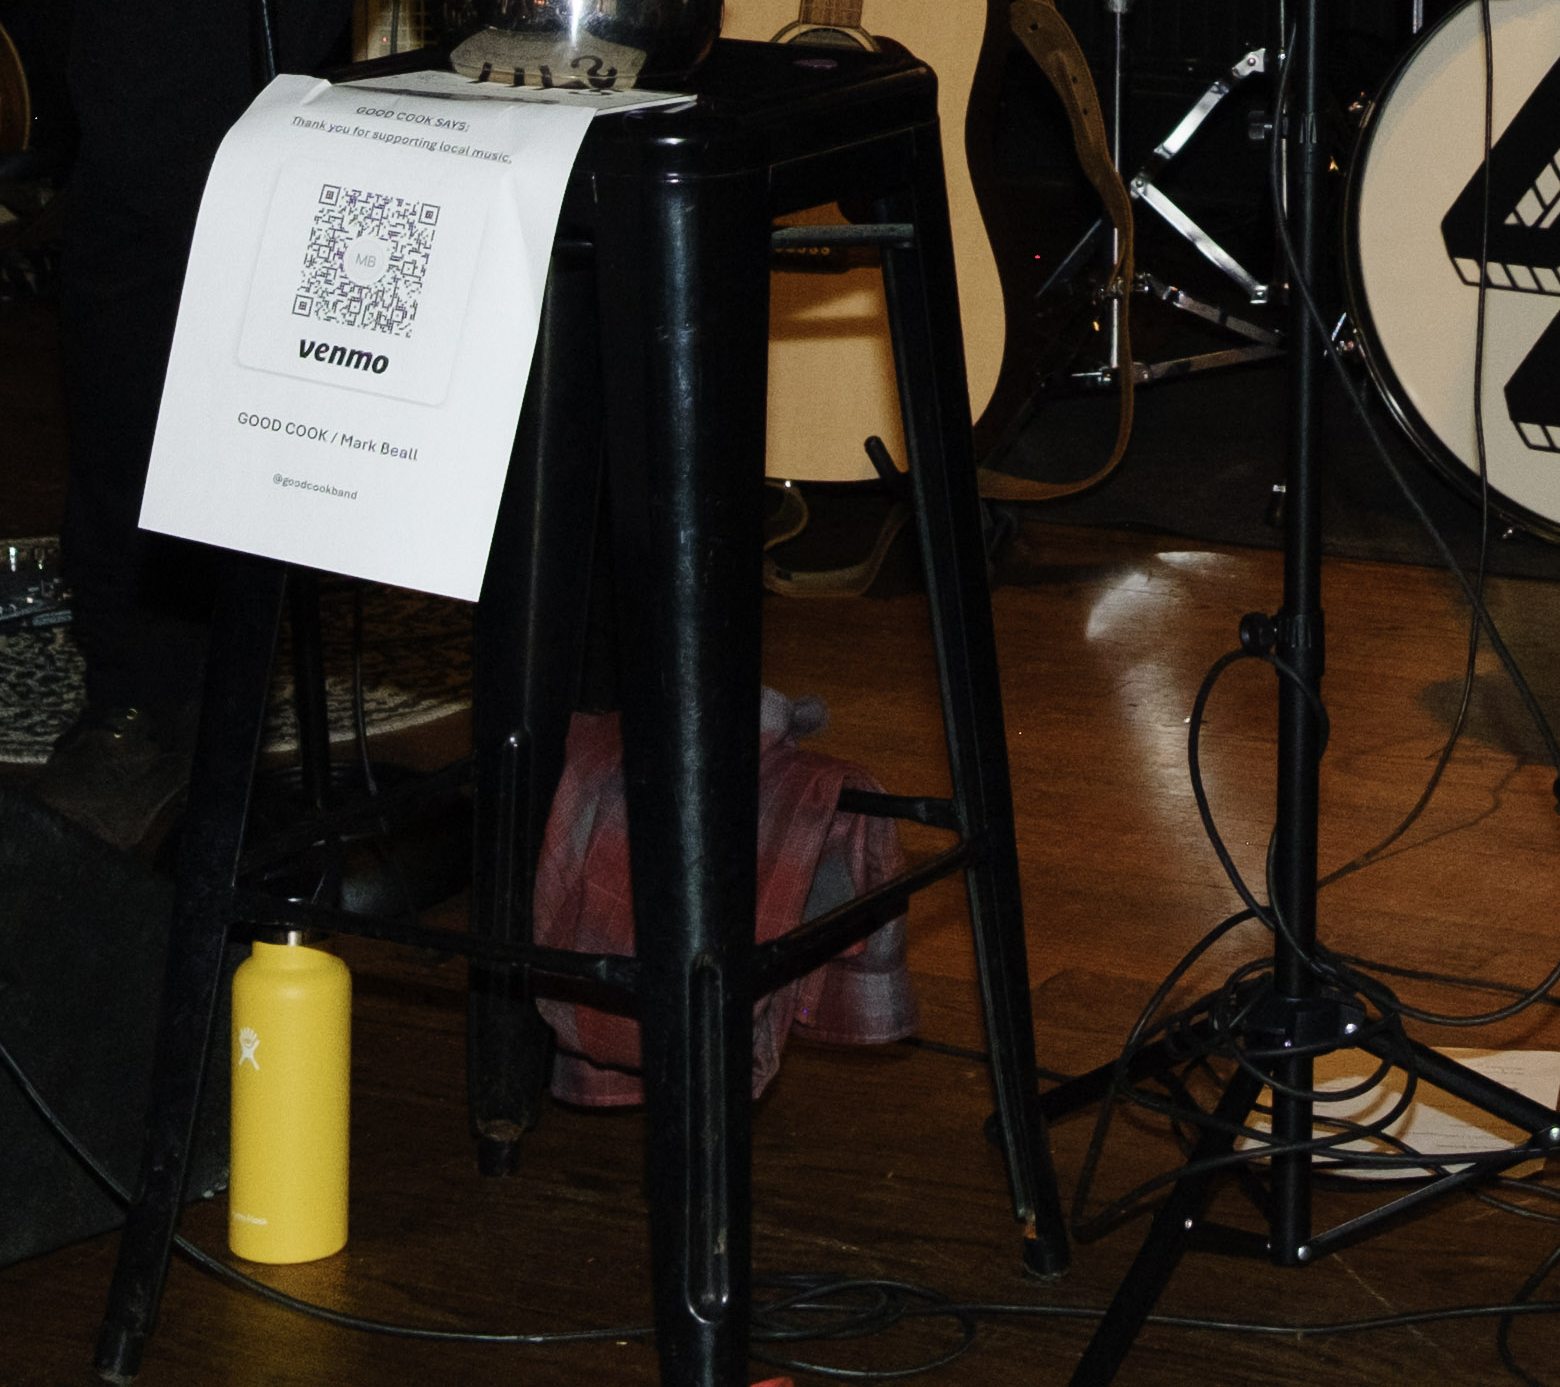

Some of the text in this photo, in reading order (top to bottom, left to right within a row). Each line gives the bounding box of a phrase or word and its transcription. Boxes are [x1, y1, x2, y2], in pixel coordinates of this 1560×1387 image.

[355, 106, 395, 120] GOOD
[395, 111, 435, 127] COOK
[291, 115, 327, 131] Thank
[327, 121, 351, 134] you
[352, 125, 371, 139] for
[371, 130, 438, 152] supporting
[438, 140, 471, 156] local
[355, 253, 377, 268] MB
[297, 337, 391, 375] venmo
[237, 411, 420, 462] GOOD COOK / Mark Beall
[272, 472, 359, 501] @goodcookband
